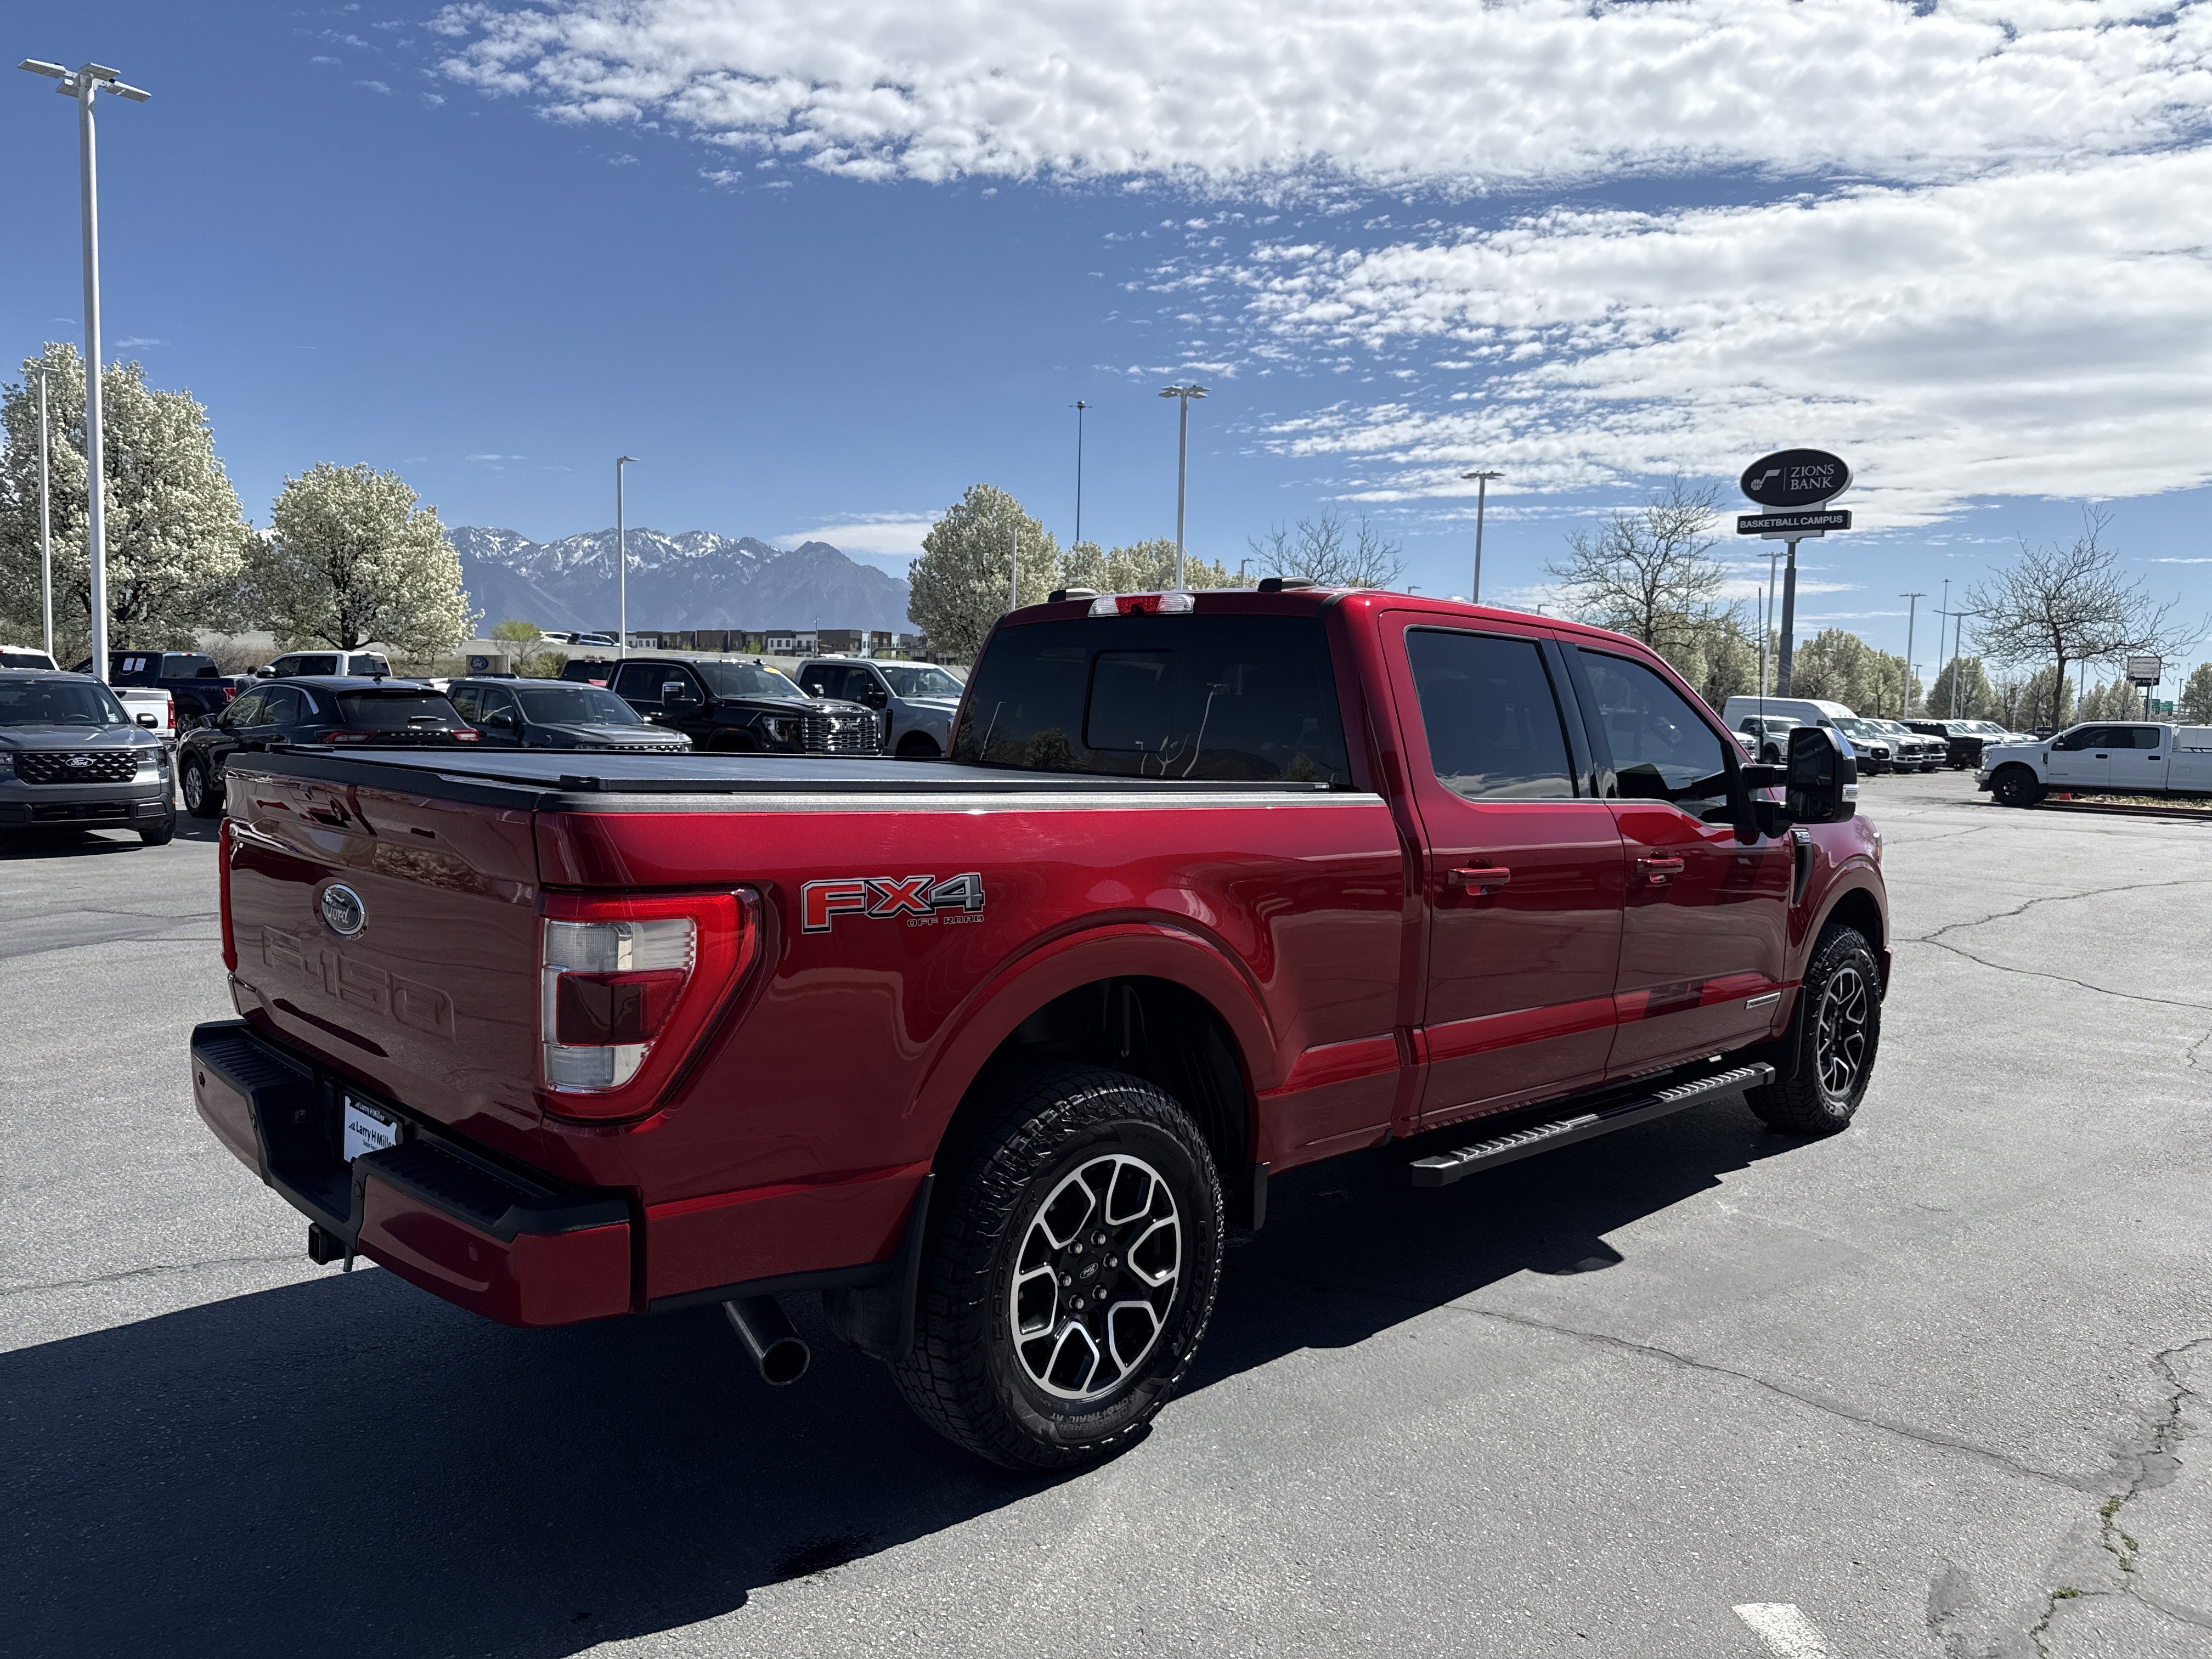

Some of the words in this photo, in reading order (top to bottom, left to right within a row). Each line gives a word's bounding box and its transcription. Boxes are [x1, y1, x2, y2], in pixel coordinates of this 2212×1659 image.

[1790, 464, 1834, 478] ZIONS
[1790, 476, 1833, 490] BANK
[1740, 518, 1799, 529] BASKETBALL
[1801, 515, 1843, 525] CAMPUS
[324, 894, 350, 924] Ford
[801, 872, 985, 934] FX4
[907, 918, 938, 927] OFF
[944, 915, 984, 925] ROAD
[359, 1101, 370, 1115] Larry
[356, 1120, 371, 1142] Larry
[371, 1129, 376, 1143] H
[993, 1190, 1037, 1341] COOPER
[1172, 1220, 1207, 1356] COOPER
[1049, 1412, 1064, 1422] AT
